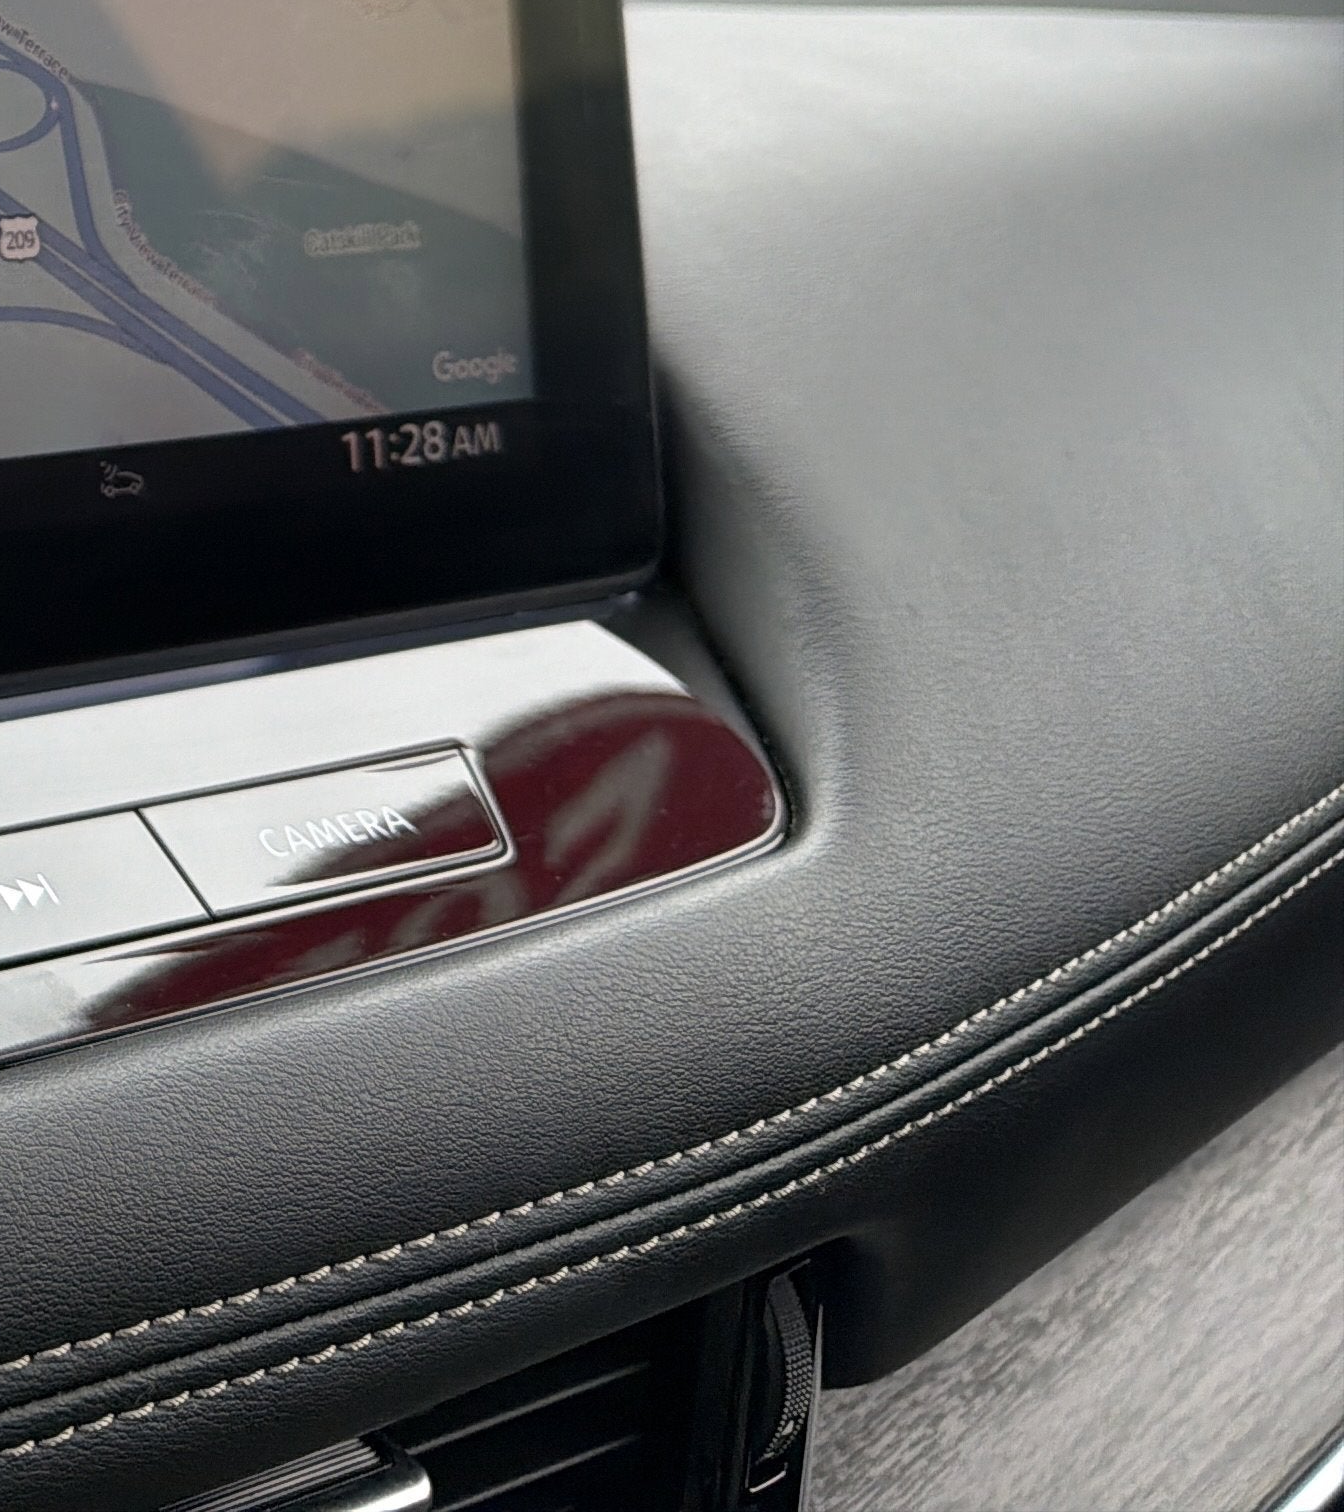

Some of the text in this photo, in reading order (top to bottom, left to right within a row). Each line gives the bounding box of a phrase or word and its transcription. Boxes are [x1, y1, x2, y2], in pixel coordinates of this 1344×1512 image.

[17, 28, 68, 79] Terrace
[5, 229, 36, 251] 209
[432, 350, 516, 384] Google
[341, 420, 501, 473] 11:28 AM
[259, 806, 421, 858] CAMERA
